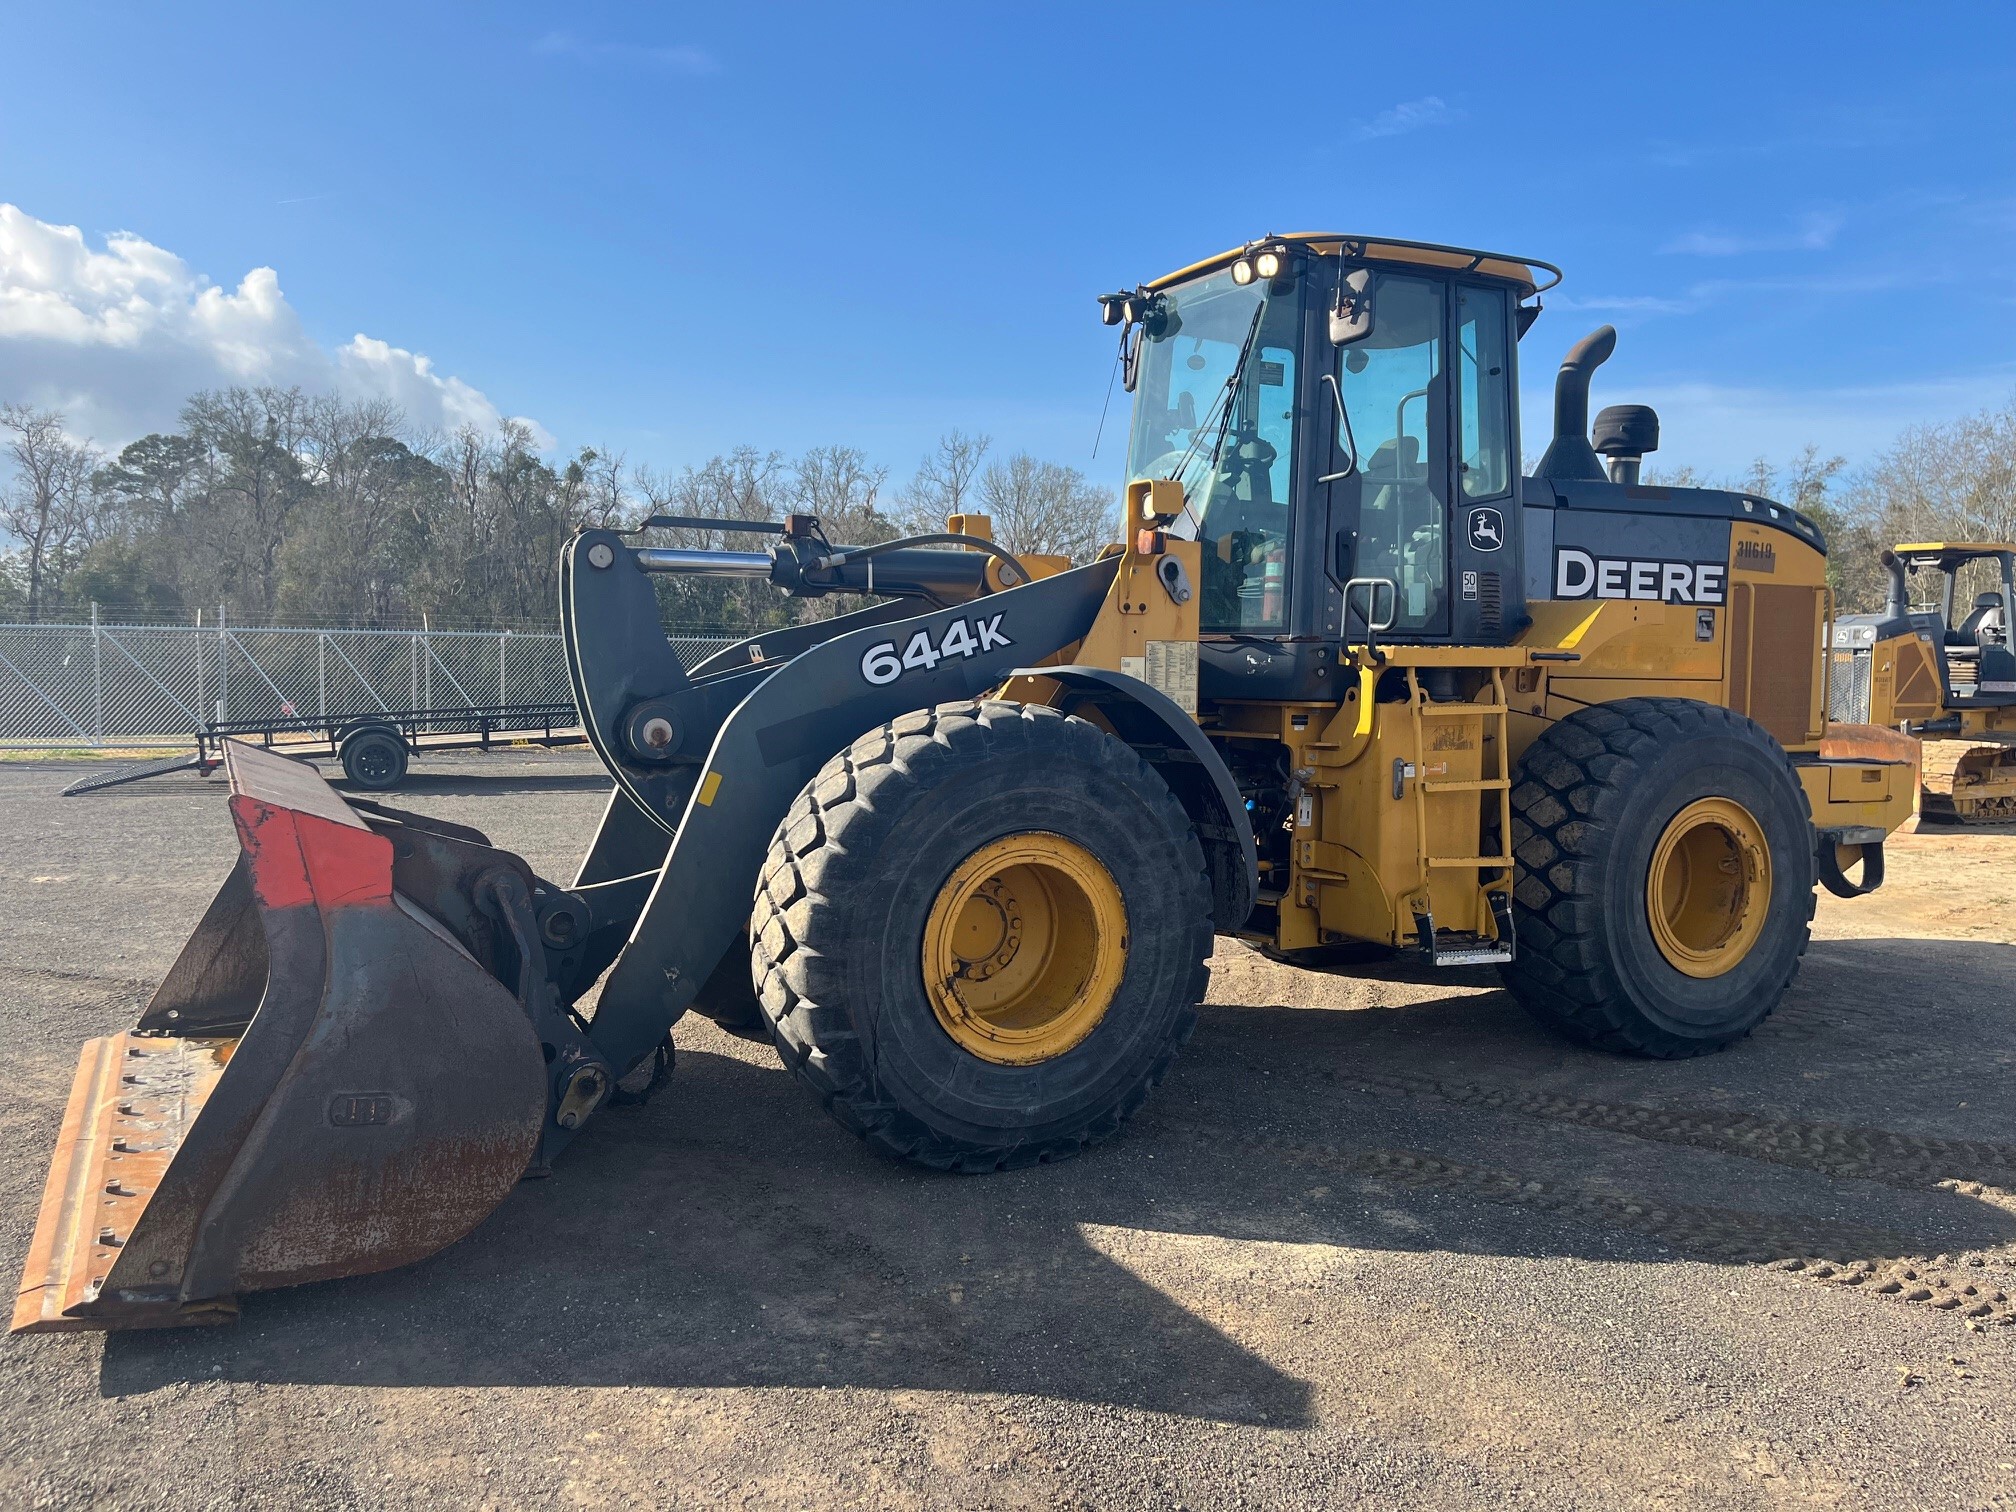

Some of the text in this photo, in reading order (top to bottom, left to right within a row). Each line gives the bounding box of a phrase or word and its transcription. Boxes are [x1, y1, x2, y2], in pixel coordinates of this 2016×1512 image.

[1464, 574, 1475, 586] 50
[1556, 549, 1724, 603] DEERE
[861, 613, 1012, 686] 644K
